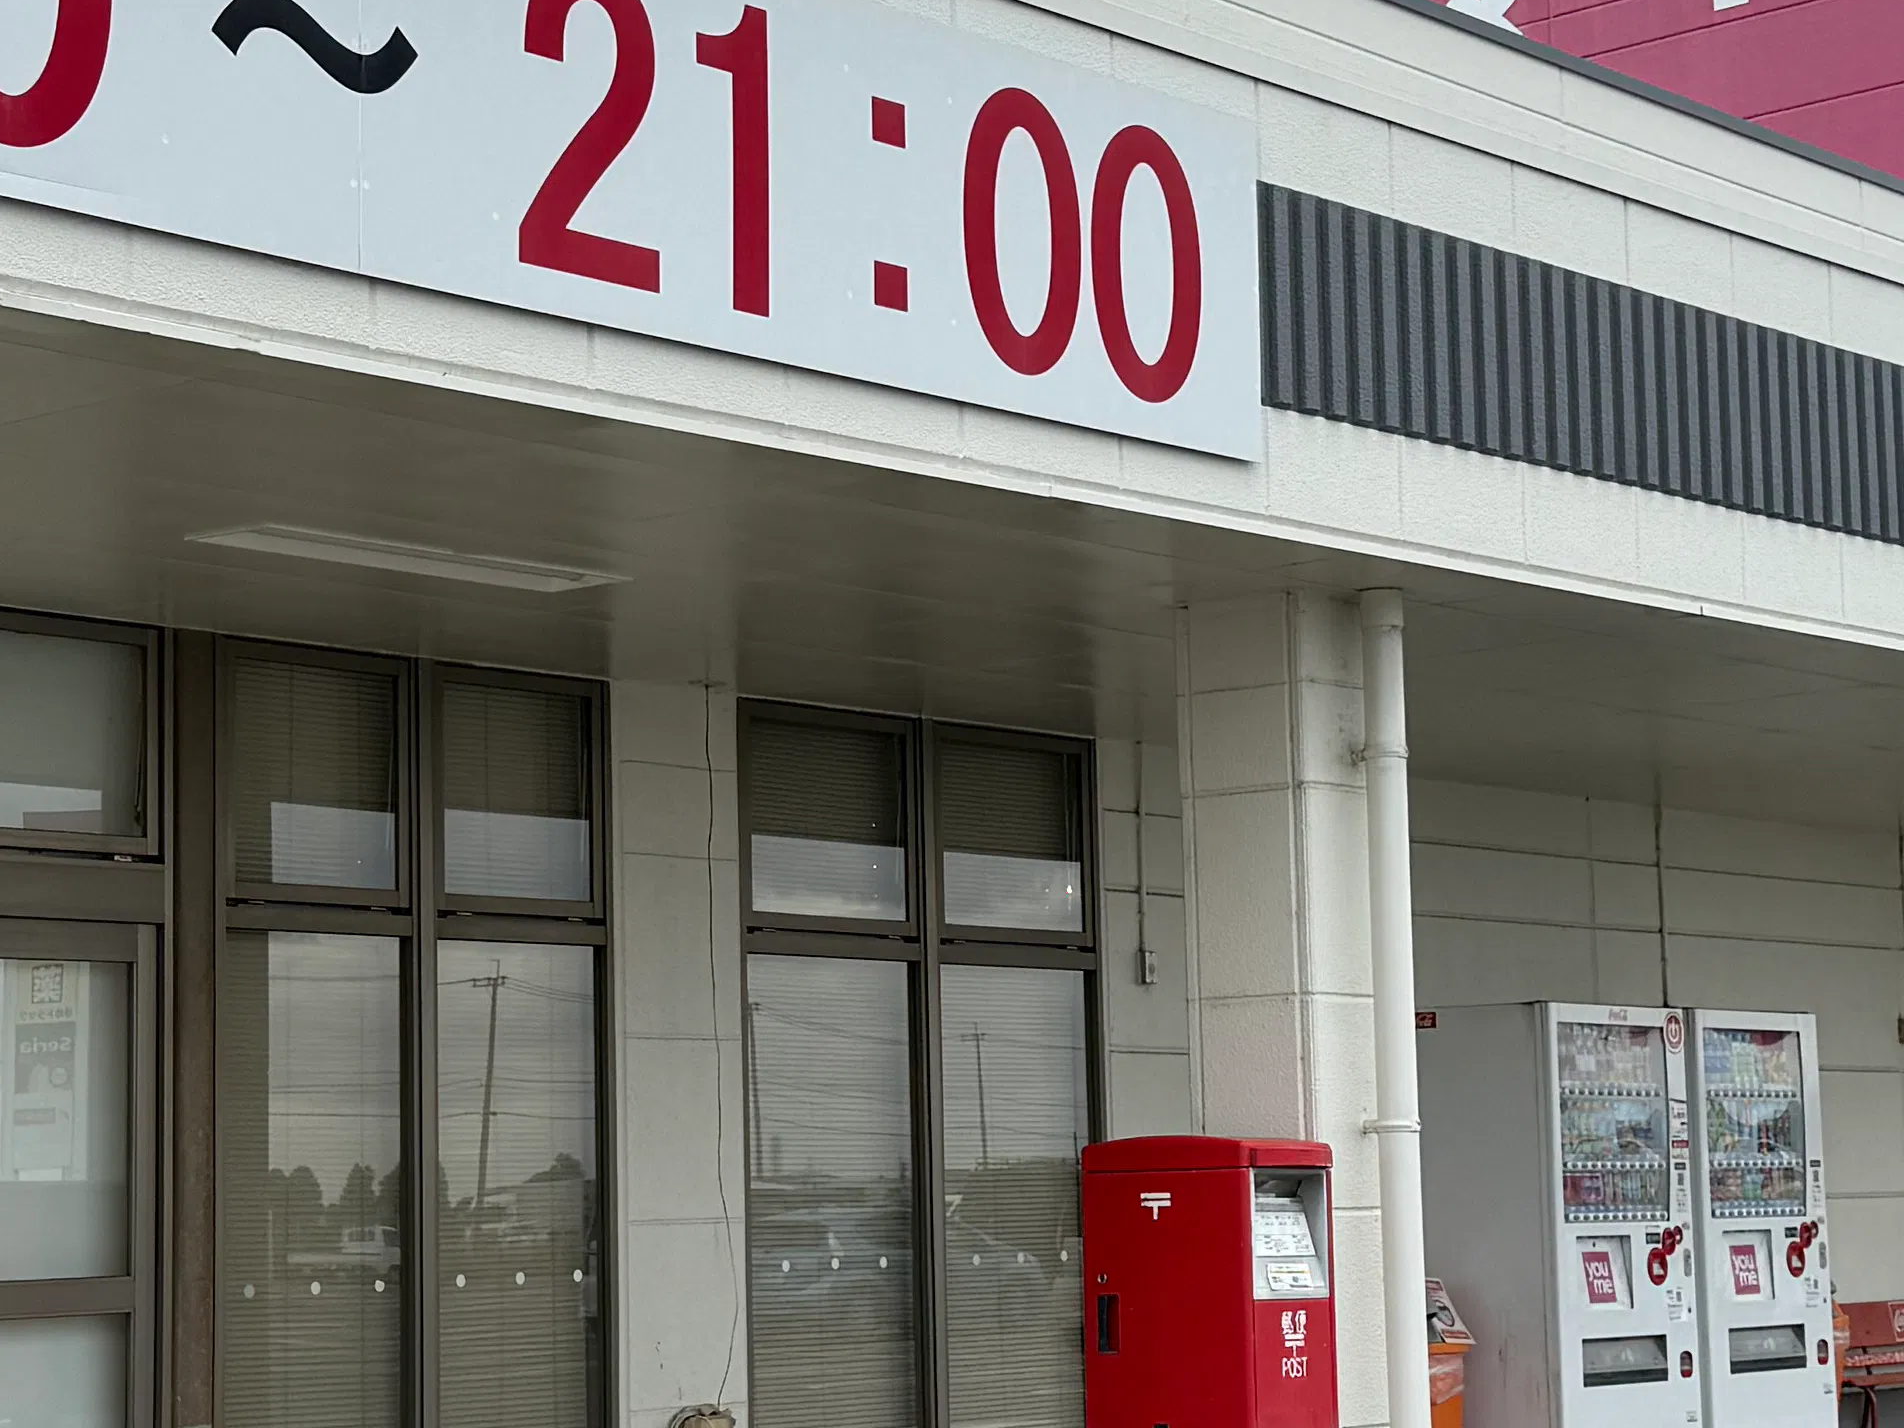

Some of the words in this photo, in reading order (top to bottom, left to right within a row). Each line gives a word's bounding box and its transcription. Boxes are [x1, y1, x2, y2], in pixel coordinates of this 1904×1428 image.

[1585, 1260, 1609, 1280] you
[1732, 1253, 1755, 1273] you
[1593, 1278, 1614, 1295] me
[1738, 1271, 1758, 1287] me
[1281, 1310, 1307, 1335] 郵便
[1281, 1357, 1308, 1379] POST
